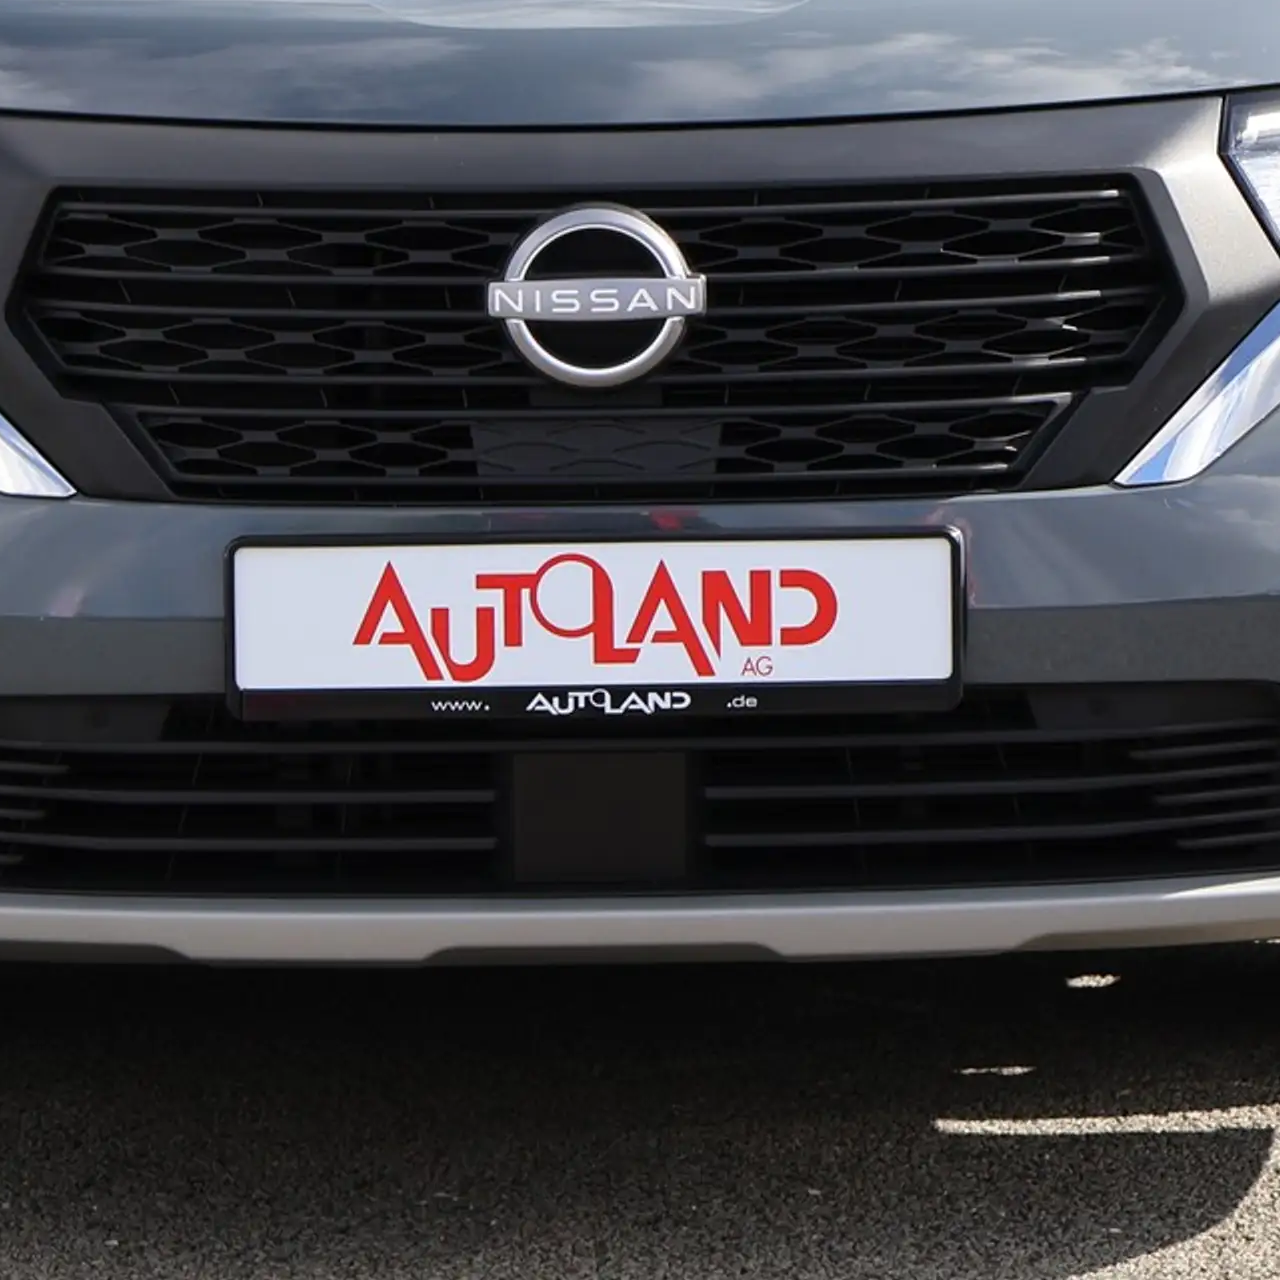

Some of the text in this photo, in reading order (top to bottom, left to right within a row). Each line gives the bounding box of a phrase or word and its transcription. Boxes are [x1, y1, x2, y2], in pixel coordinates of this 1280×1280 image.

[493, 286, 696, 314] NISSAN
[354, 554, 837, 681] AUTOLAND
[741, 655, 774, 677] AG
